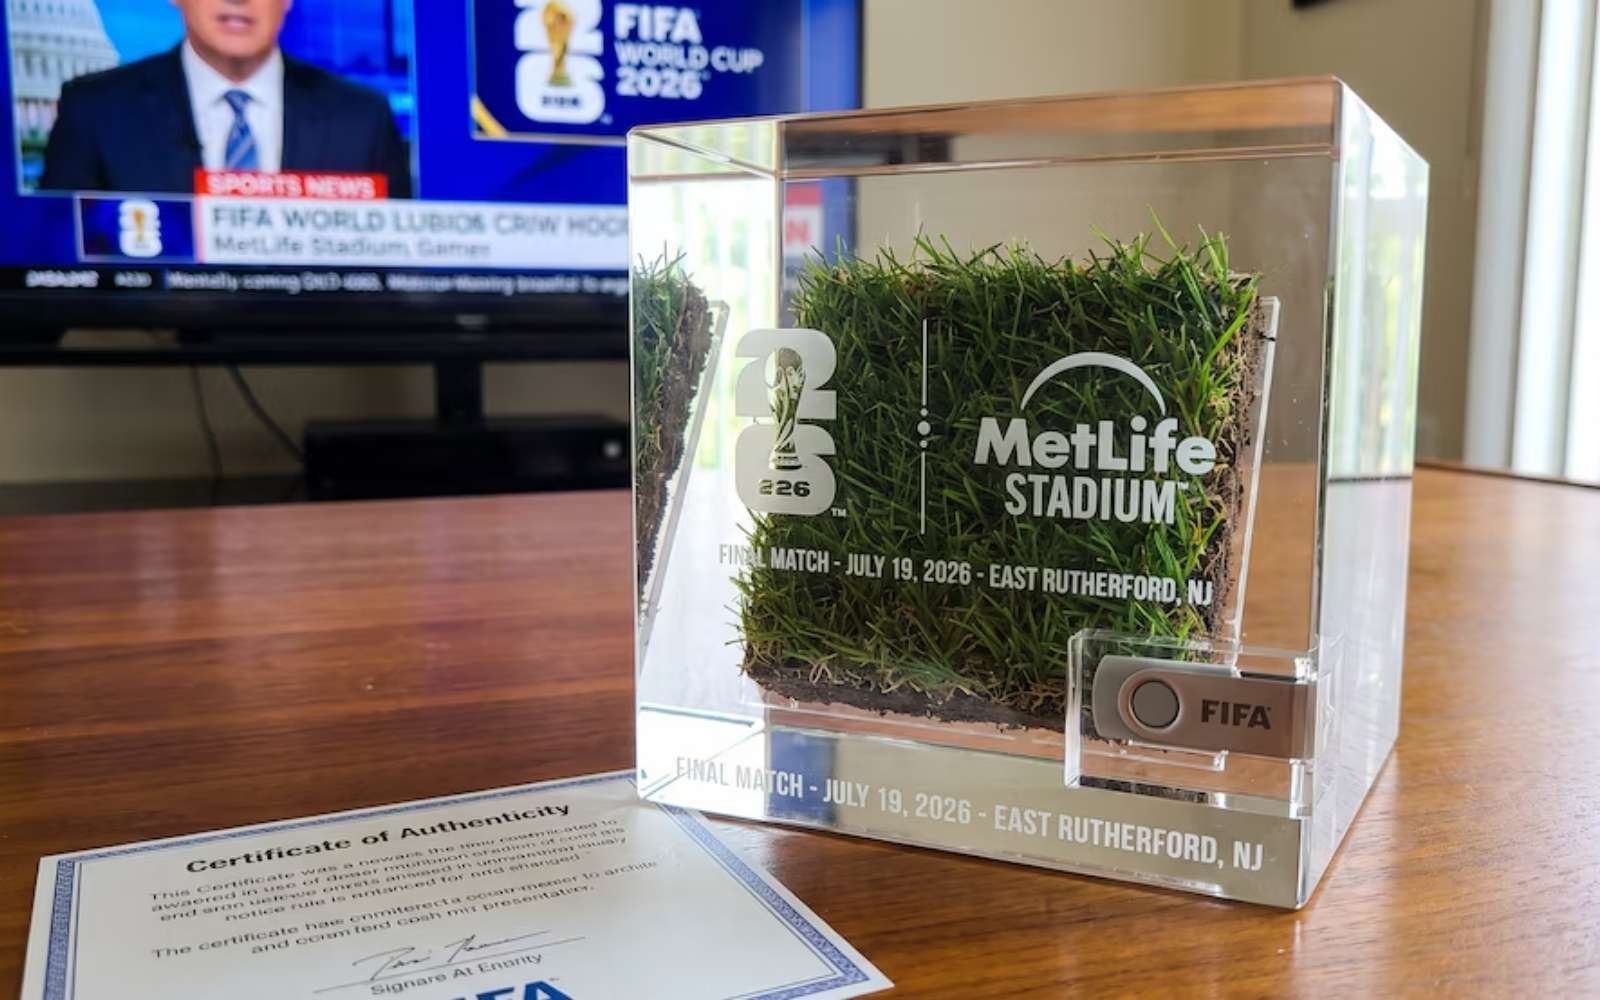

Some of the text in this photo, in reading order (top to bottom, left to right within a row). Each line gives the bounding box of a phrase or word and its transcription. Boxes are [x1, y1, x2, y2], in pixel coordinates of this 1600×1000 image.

[614, 3, 703, 43] FIFA
[615, 41, 764, 73] WORLD CUP
[616, 67, 703, 99] 2026
[207, 175, 375, 198] SPORTS NEWS
[213, 207, 272, 228] FIFA
[281, 208, 385, 232] WORLD
[974, 415, 1216, 475] MetLife
[1005, 472, 1176, 524] STADIUM
[719, 543, 766, 568] FINAL
[770, 546, 830, 574] MATCH
[845, 553, 886, 579] JULY
[892, 557, 918, 584] 19,
[922, 559, 972, 587] 2026
[989, 563, 1039, 592] EAST
[1041, 567, 1182, 607] RUTHERFORD,
[1187, 578, 1214, 607] NJ
[1202, 699, 1271, 730] FIFA
[676, 756, 729, 787] FINAL
[736, 764, 803, 798] MATCH
[823, 778, 871, 809] JULY
[878, 787, 908, 818] 19,
[915, 793, 971, 824] 2026
[994, 804, 1052, 835] EAST
[1058, 813, 1225, 870] RUTHERFORD,
[1233, 840, 1264, 872] NJ
[186, 804, 569, 874] Certificate of Authenticity
[151, 888, 190, 902] This
[197, 870, 295, 894] Certificate
[152, 943, 191, 959] The
[199, 926, 299, 950] certificate
[251, 939, 289, 955] and
[453, 965, 473, 979] At
